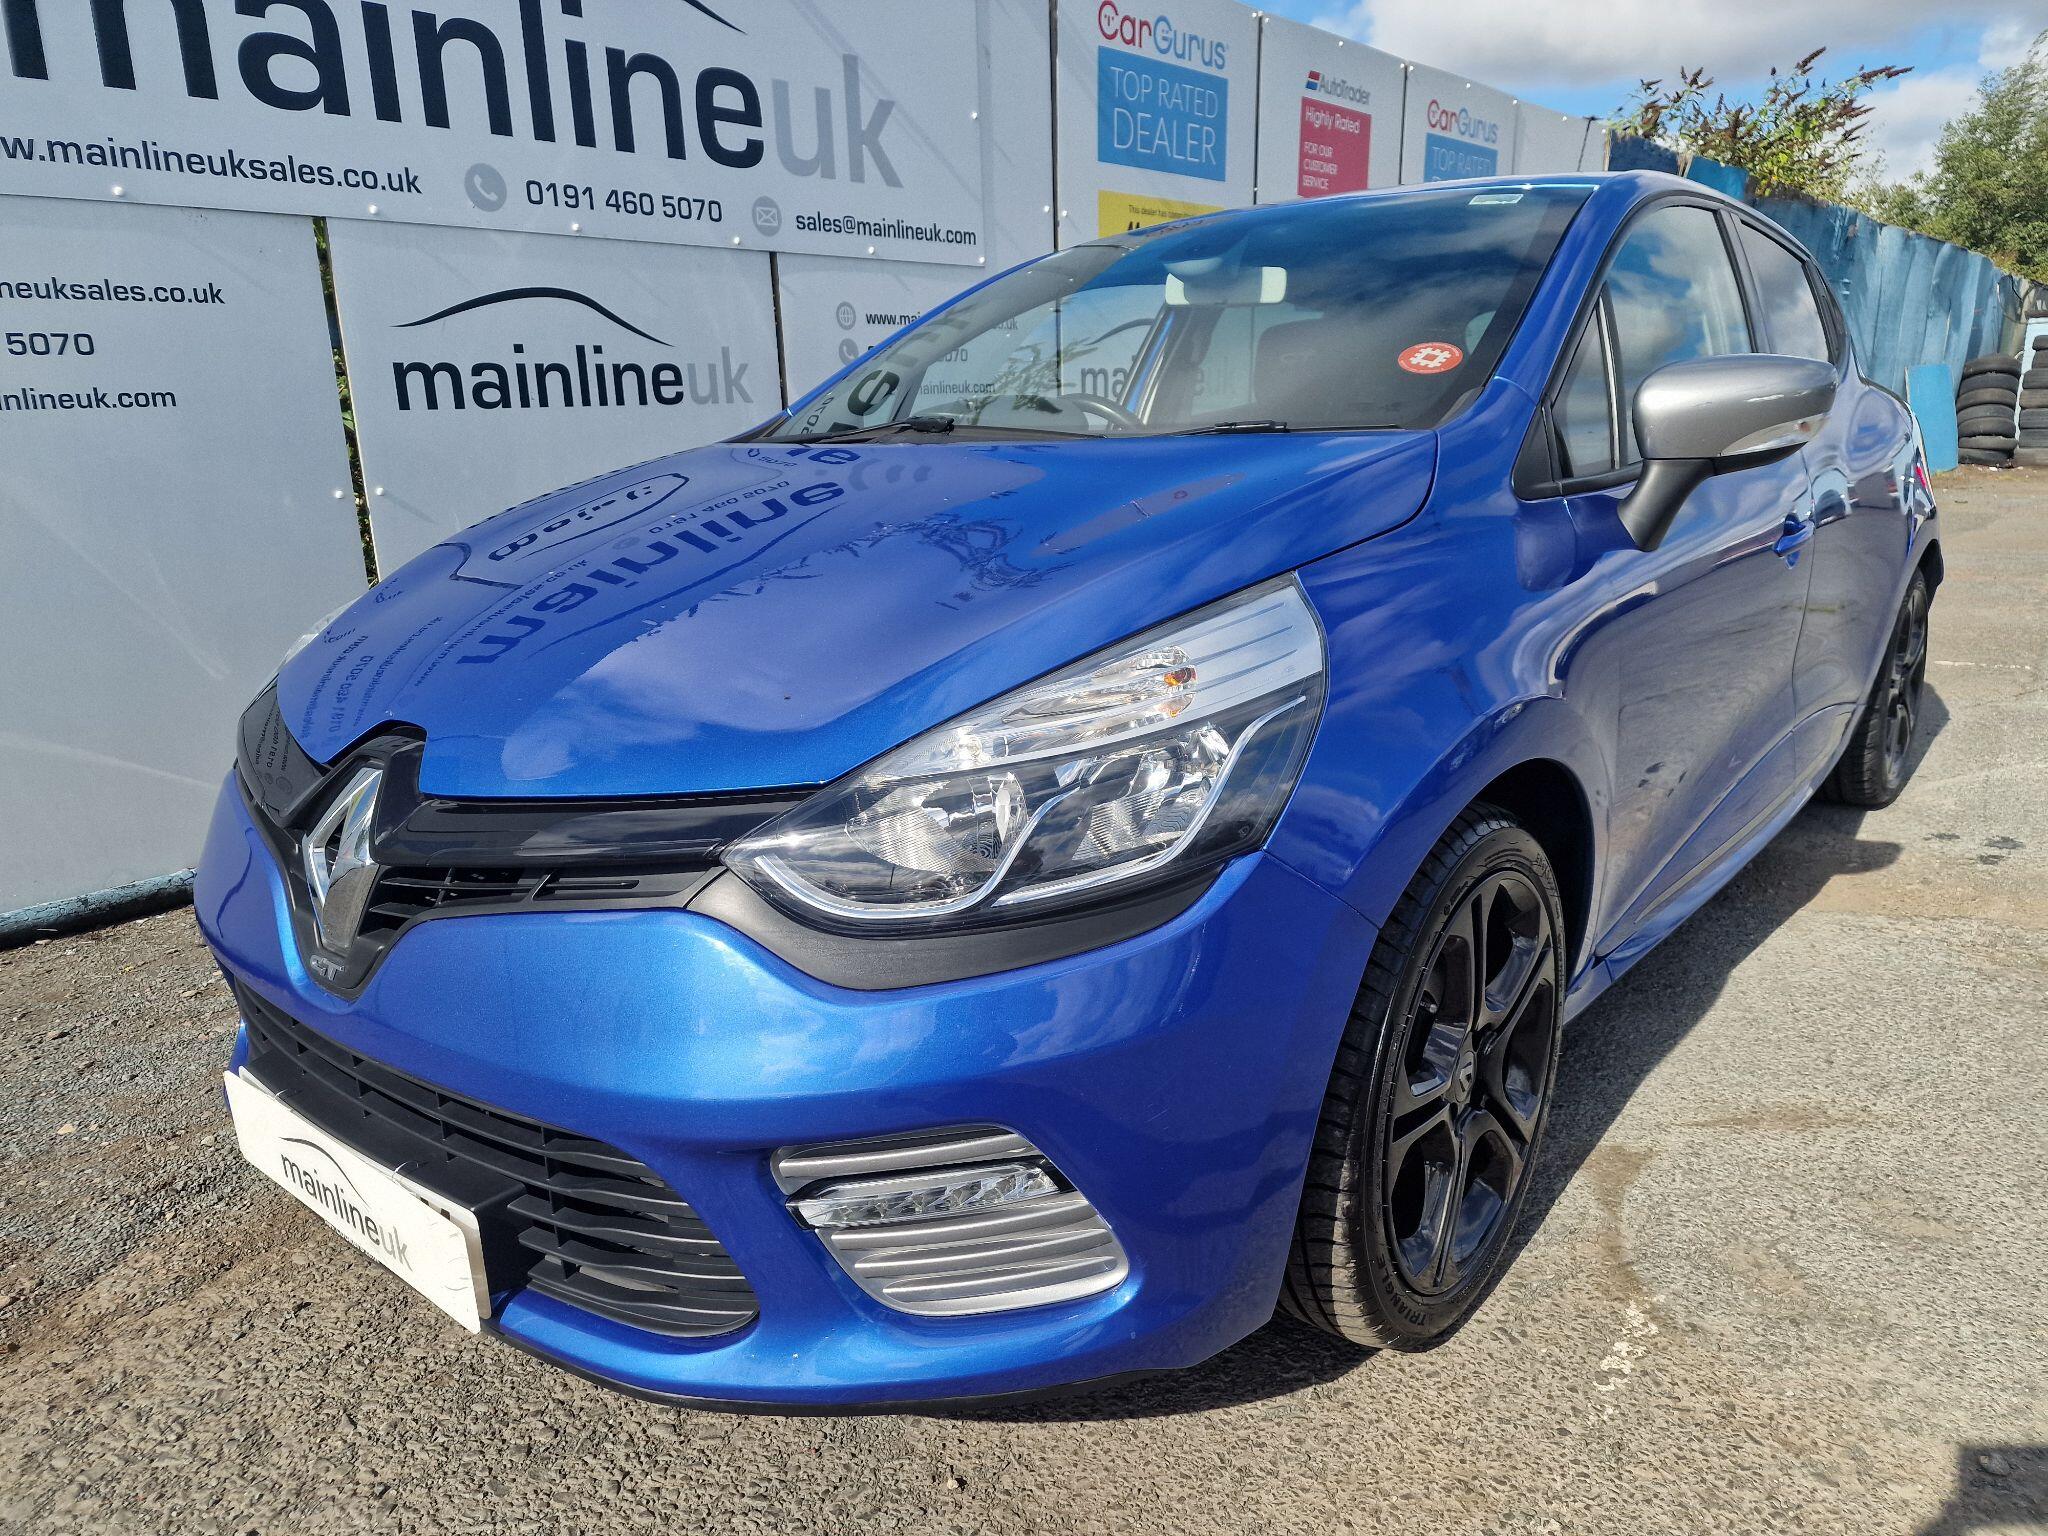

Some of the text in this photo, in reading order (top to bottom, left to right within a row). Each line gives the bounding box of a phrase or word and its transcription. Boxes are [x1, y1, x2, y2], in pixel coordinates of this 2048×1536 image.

[1098, 0, 1226, 70] CarGurus
[1110, 66, 1218, 119] TOP RATED
[1113, 107, 1217, 165] DEALER
[1305, 105, 1361, 134] Highly Rated
[1427, 99, 1498, 144] CarGurus
[1303, 158, 1338, 175] CUSTOMER
[1304, 141, 1334, 157] FOR OUR
[1432, 147, 1456, 172] TOP
[526, 180, 723, 222] 0191 460 5070
[1302, 174, 1329, 190] SERVICE
[796, 211, 977, 246] sales@mainlineuk.com
[6, 332, 95, 356] 5070
[392, 343, 754, 411] mainlineuk
[280, 1153, 413, 1273] mainlineuk
